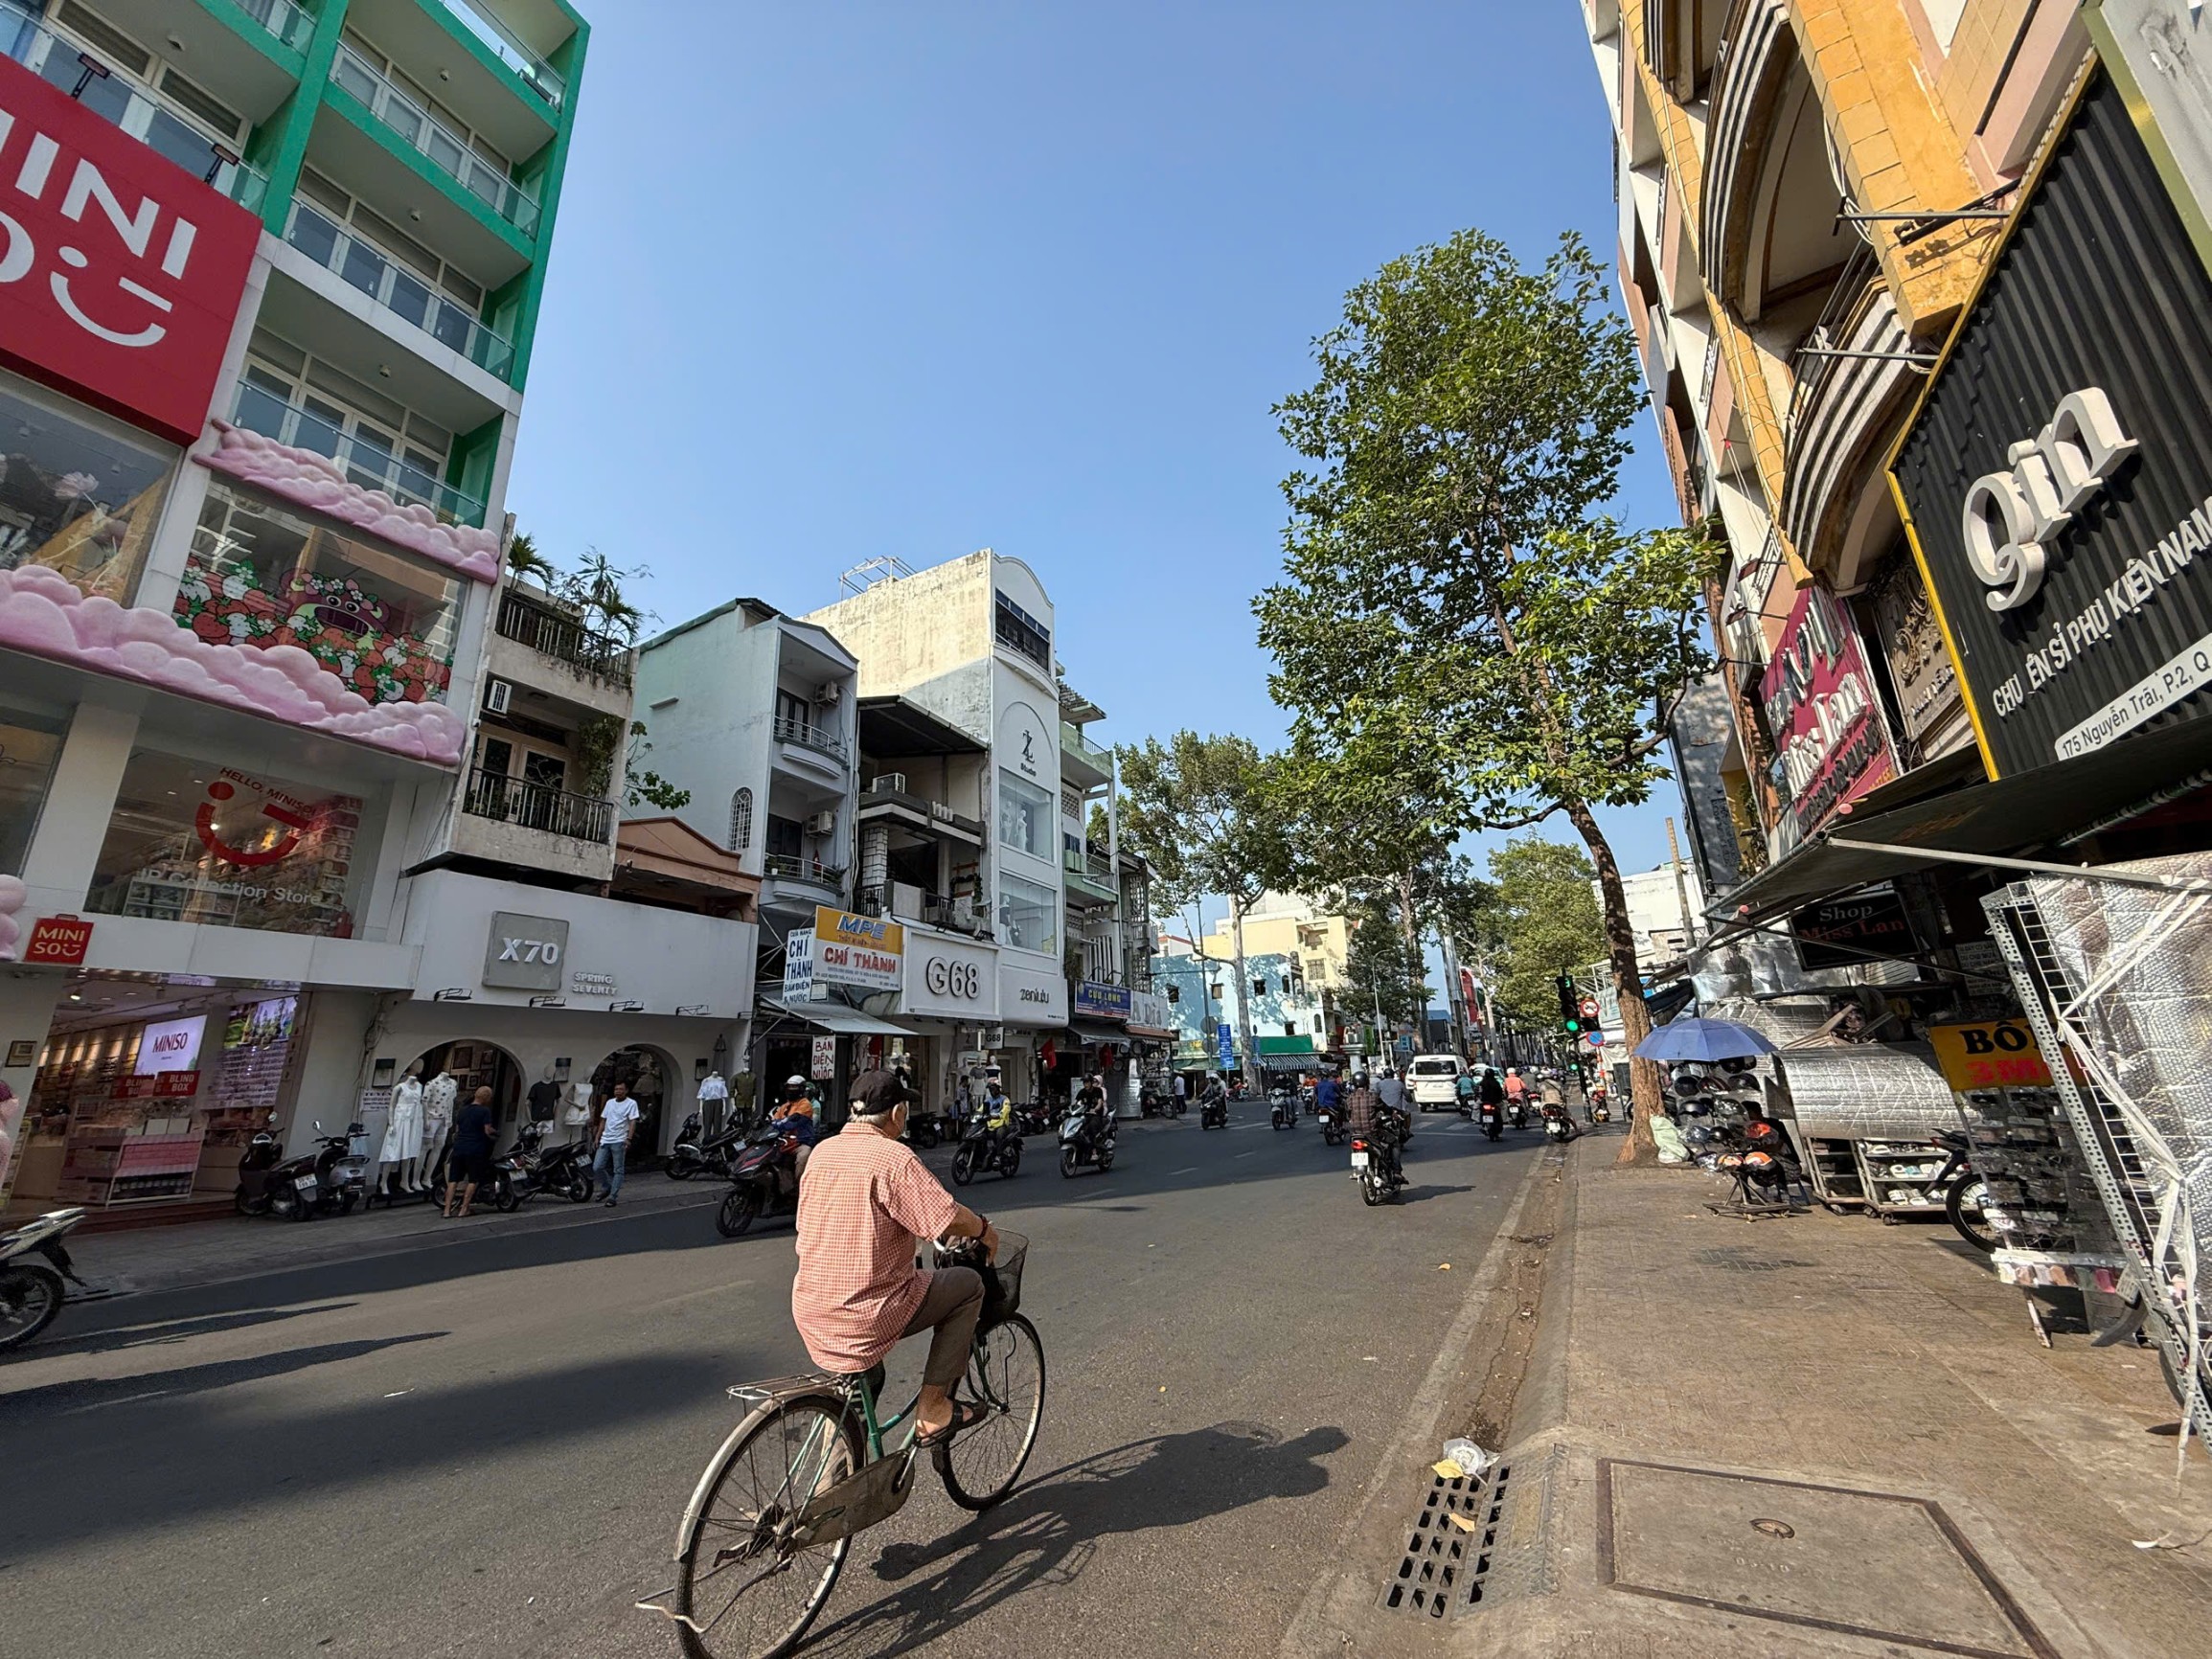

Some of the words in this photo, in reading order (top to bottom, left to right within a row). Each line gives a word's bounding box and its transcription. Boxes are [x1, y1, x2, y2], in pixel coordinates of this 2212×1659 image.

[2066, 598, 2112, 655] PHỤ
[2105, 558, 2170, 622] KIỆN
[2157, 496, 2212, 576] NAM
[2062, 736, 2082, 758] 175
[2081, 706, 2130, 745] Nguyễn
[220, 767, 263, 792] HELLO,
[272, 887, 323, 906] Store
[1819, 905, 1873, 921] Shop
[37, 926, 85, 942] MINI
[837, 915, 887, 940] MPE
[1858, 920, 1904, 936] Lan
[498, 938, 559, 966] X70
[824, 946, 850, 966] CHÍ
[854, 951, 897, 974] THÀNH
[575, 972, 613, 985] SPRING
[925, 956, 981, 999] G68
[573, 984, 618, 996] SEVENTY
[152, 1032, 188, 1053] MINISO
[815, 1037, 832, 1052] BÁN
[986, 1034, 1001, 1042] G68
[170, 1073, 195, 1083] BLIND
[171, 1082, 189, 1092] BOX
